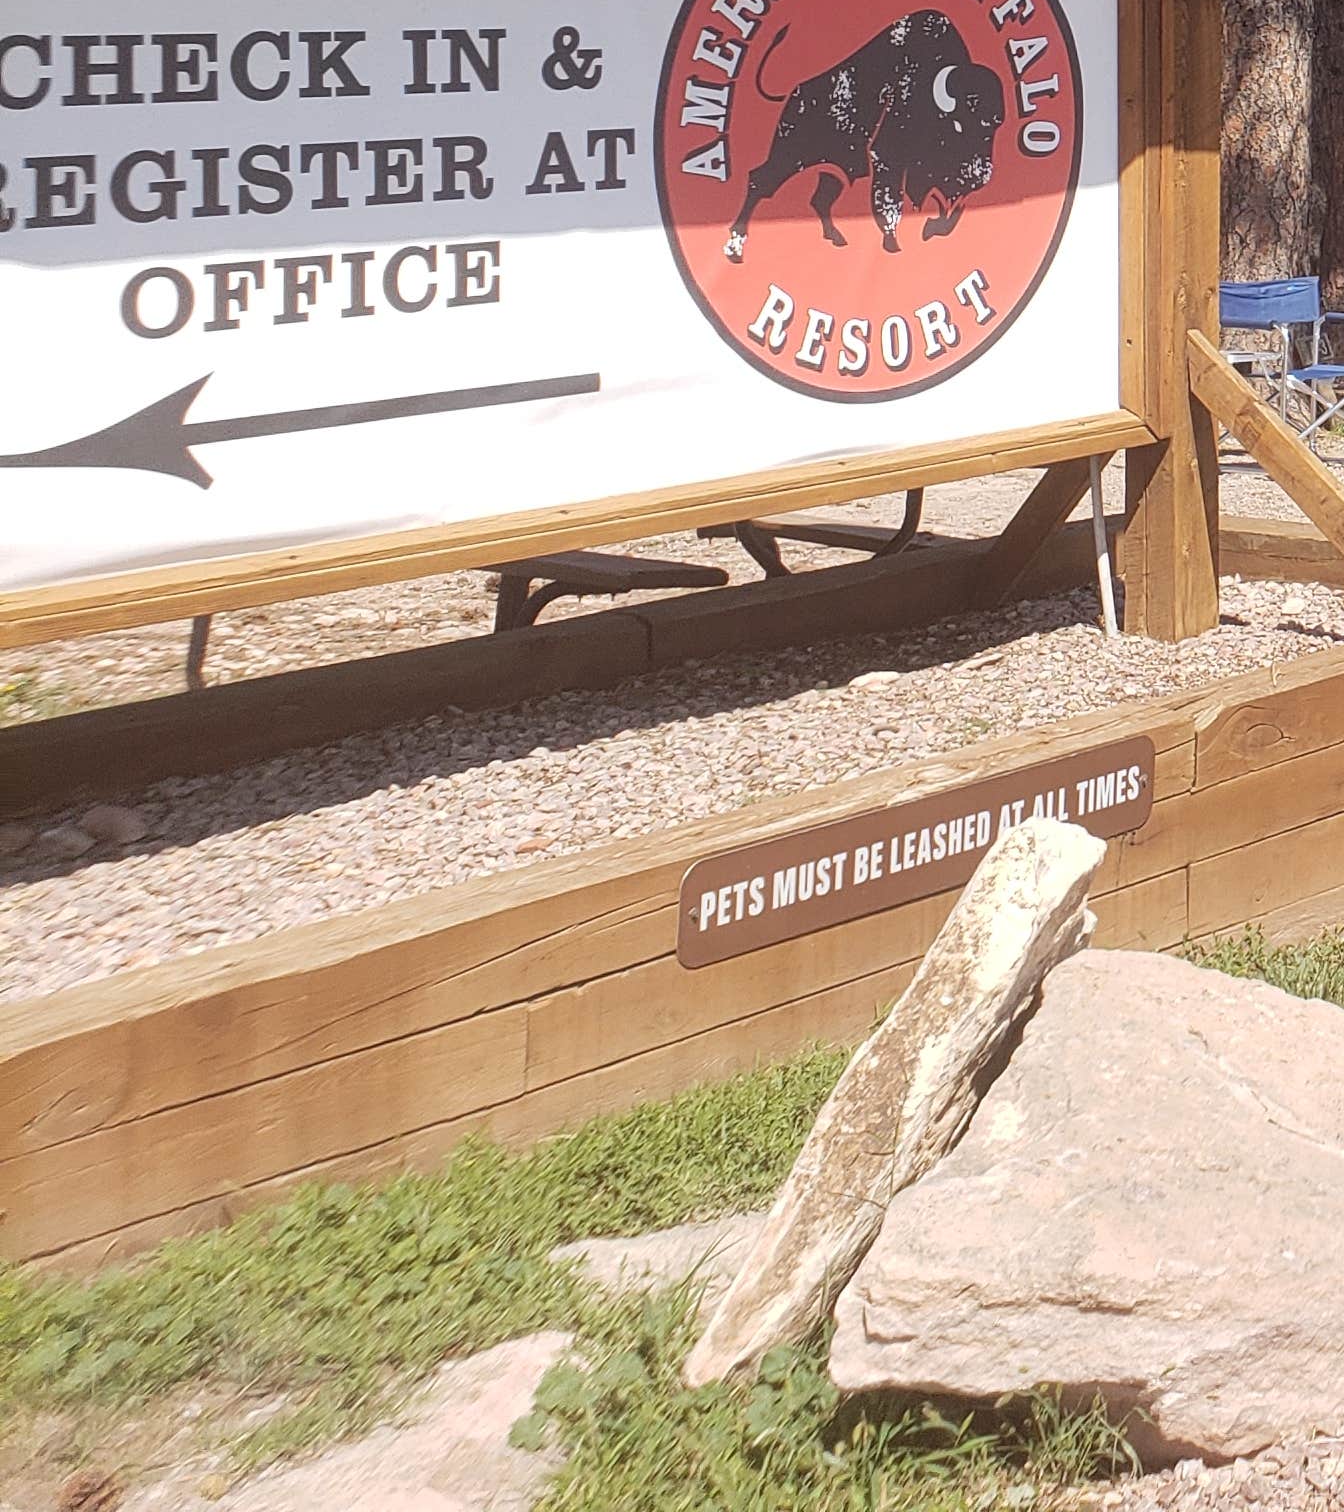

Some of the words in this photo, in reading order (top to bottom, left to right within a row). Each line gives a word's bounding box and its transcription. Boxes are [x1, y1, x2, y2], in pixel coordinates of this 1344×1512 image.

[0, 29, 371, 110] CHECK
[403, 28, 507, 96] IN
[541, 25, 603, 90] &
[0, 134, 495, 234] EGISTER
[525, 128, 637, 196] AT
[120, 240, 502, 340] OFFICE
[746, 268, 995, 376] RESORT
[699, 876, 766, 932] PETS
[771, 851, 847, 909] MUST
[853, 846, 883, 884] BE
[889, 809, 992, 875] LEASHED
[996, 799, 1025, 837] AT
[1032, 787, 1069, 823] ALL
[1076, 765, 1140, 817] TIMES
